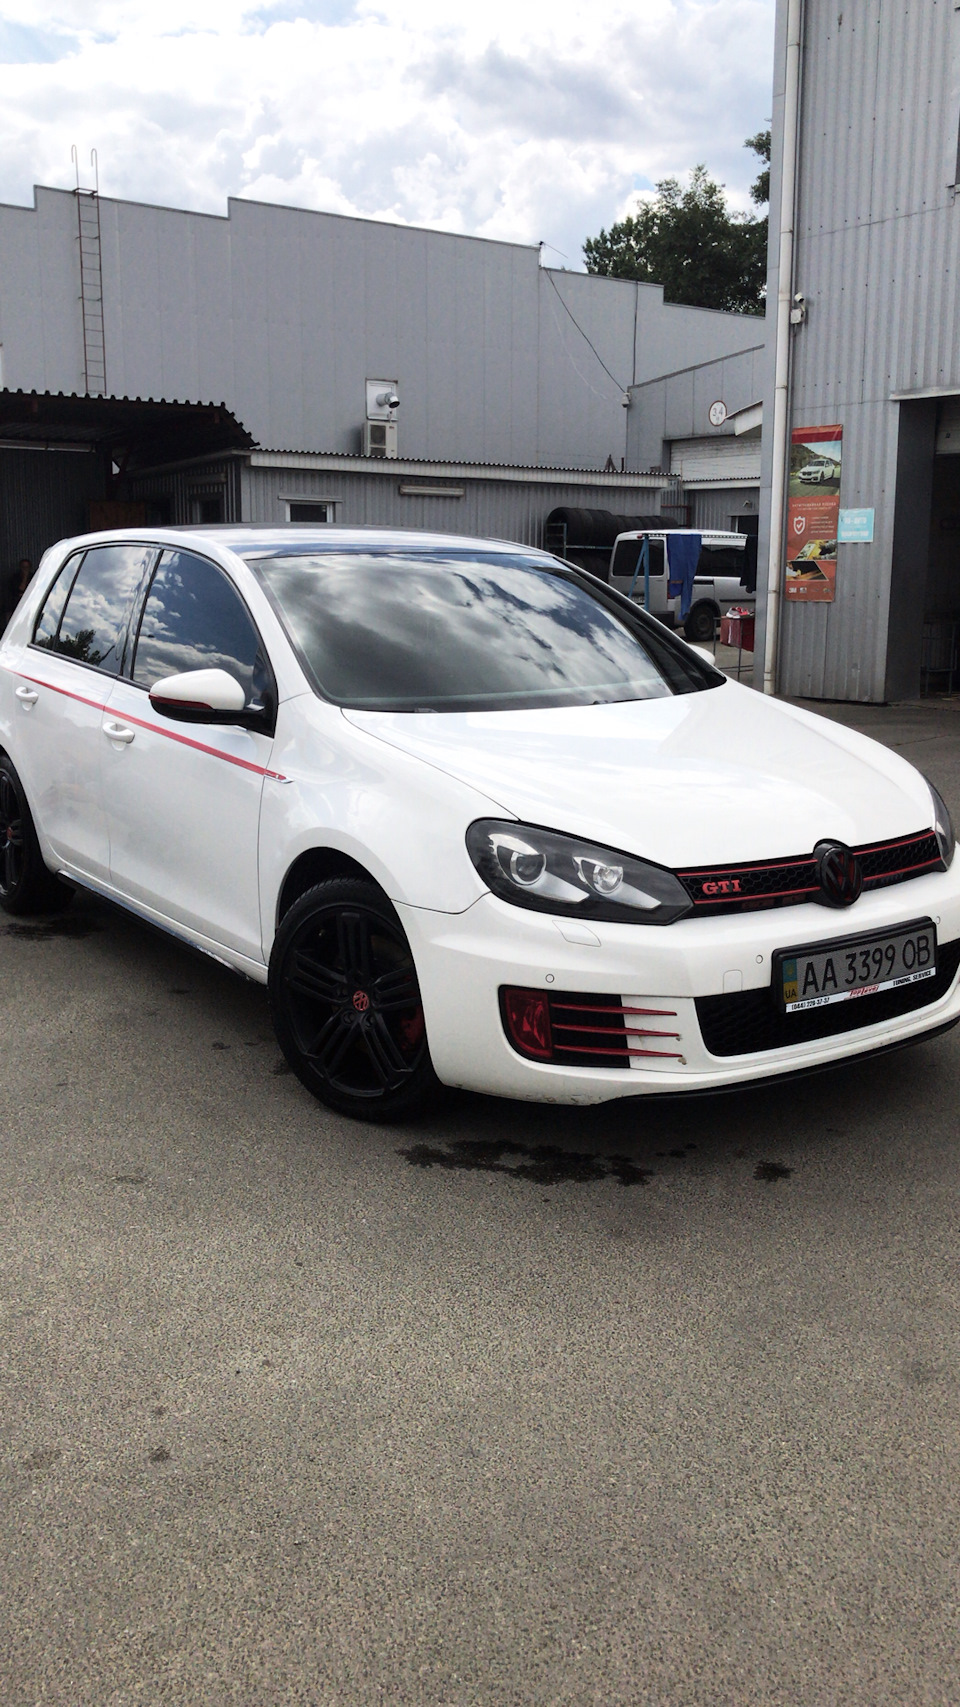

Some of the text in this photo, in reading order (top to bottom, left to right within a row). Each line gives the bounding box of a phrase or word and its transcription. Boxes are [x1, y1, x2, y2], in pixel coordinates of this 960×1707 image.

[702, 879, 742, 895] GTI
[802, 935, 931, 995] AA 3399 OB
[785, 989, 797, 999] UA
